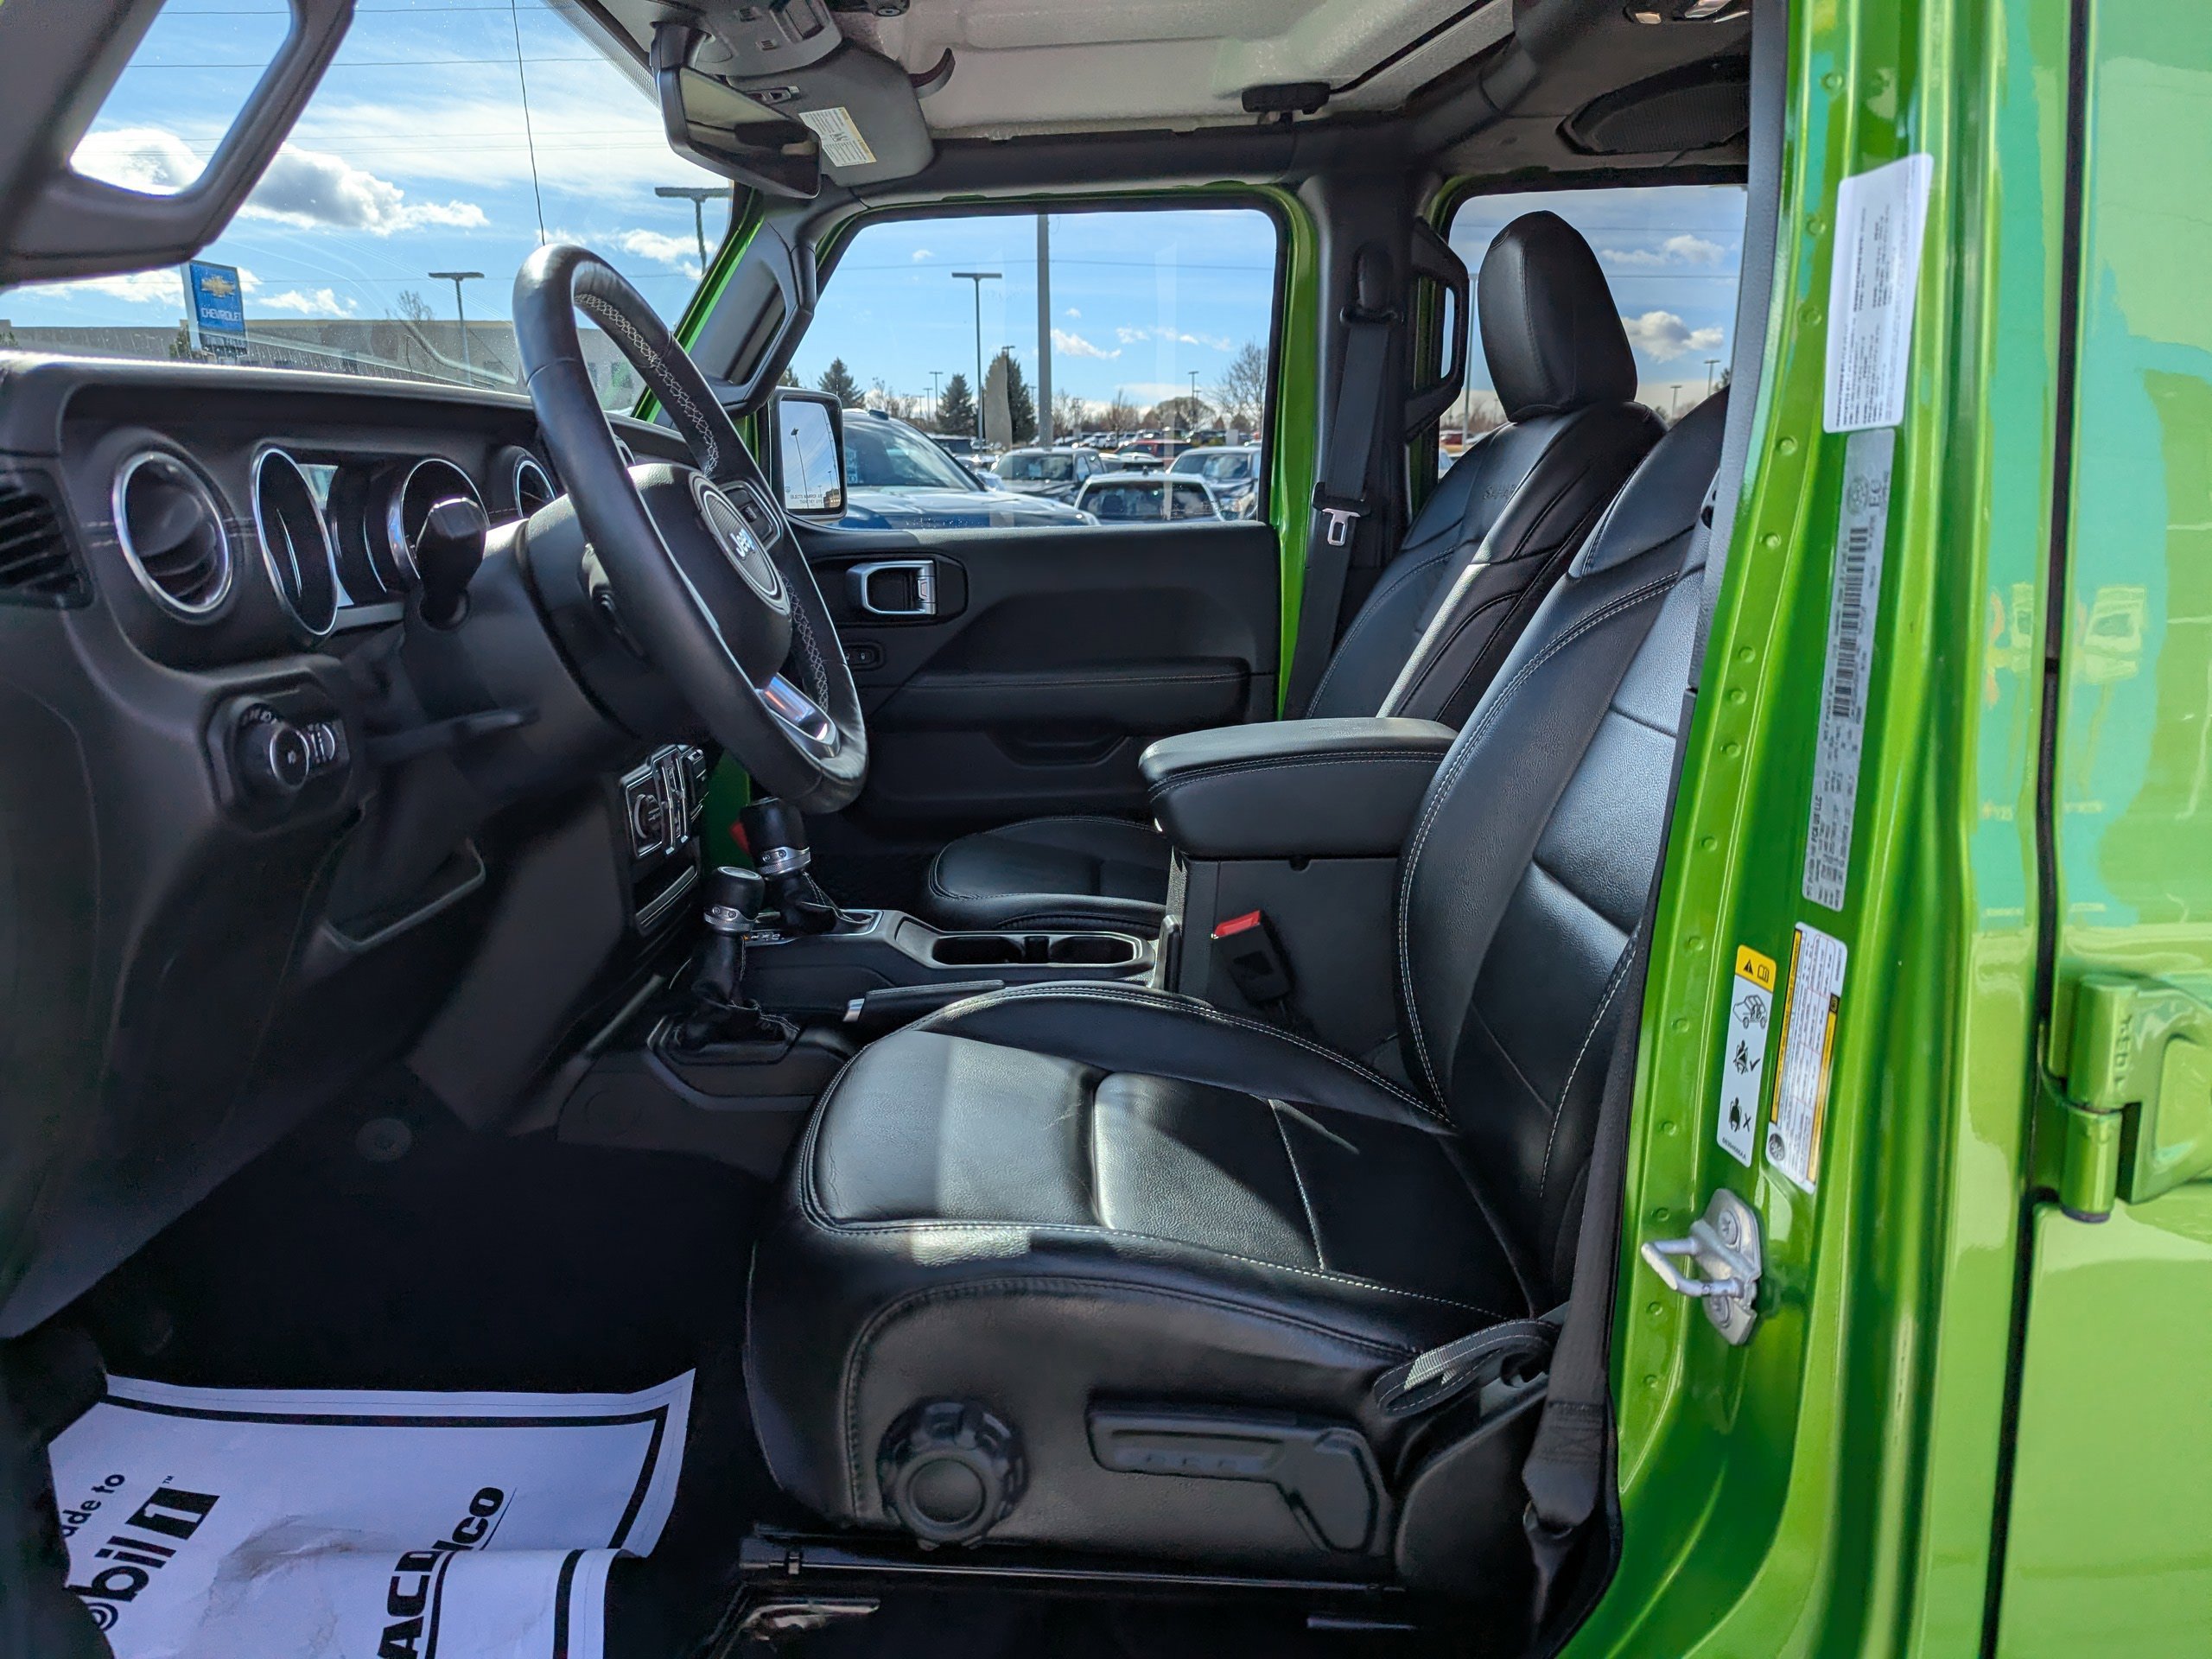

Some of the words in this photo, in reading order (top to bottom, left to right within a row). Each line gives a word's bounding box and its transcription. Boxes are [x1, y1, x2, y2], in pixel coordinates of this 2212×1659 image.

[200, 308, 242, 321] CHEVROLET
[729, 528, 755, 559] Jeep
[61, 1500, 102, 1538] ade
[92, 1473, 126, 1494] to
[62, 1535, 177, 1631] obil
